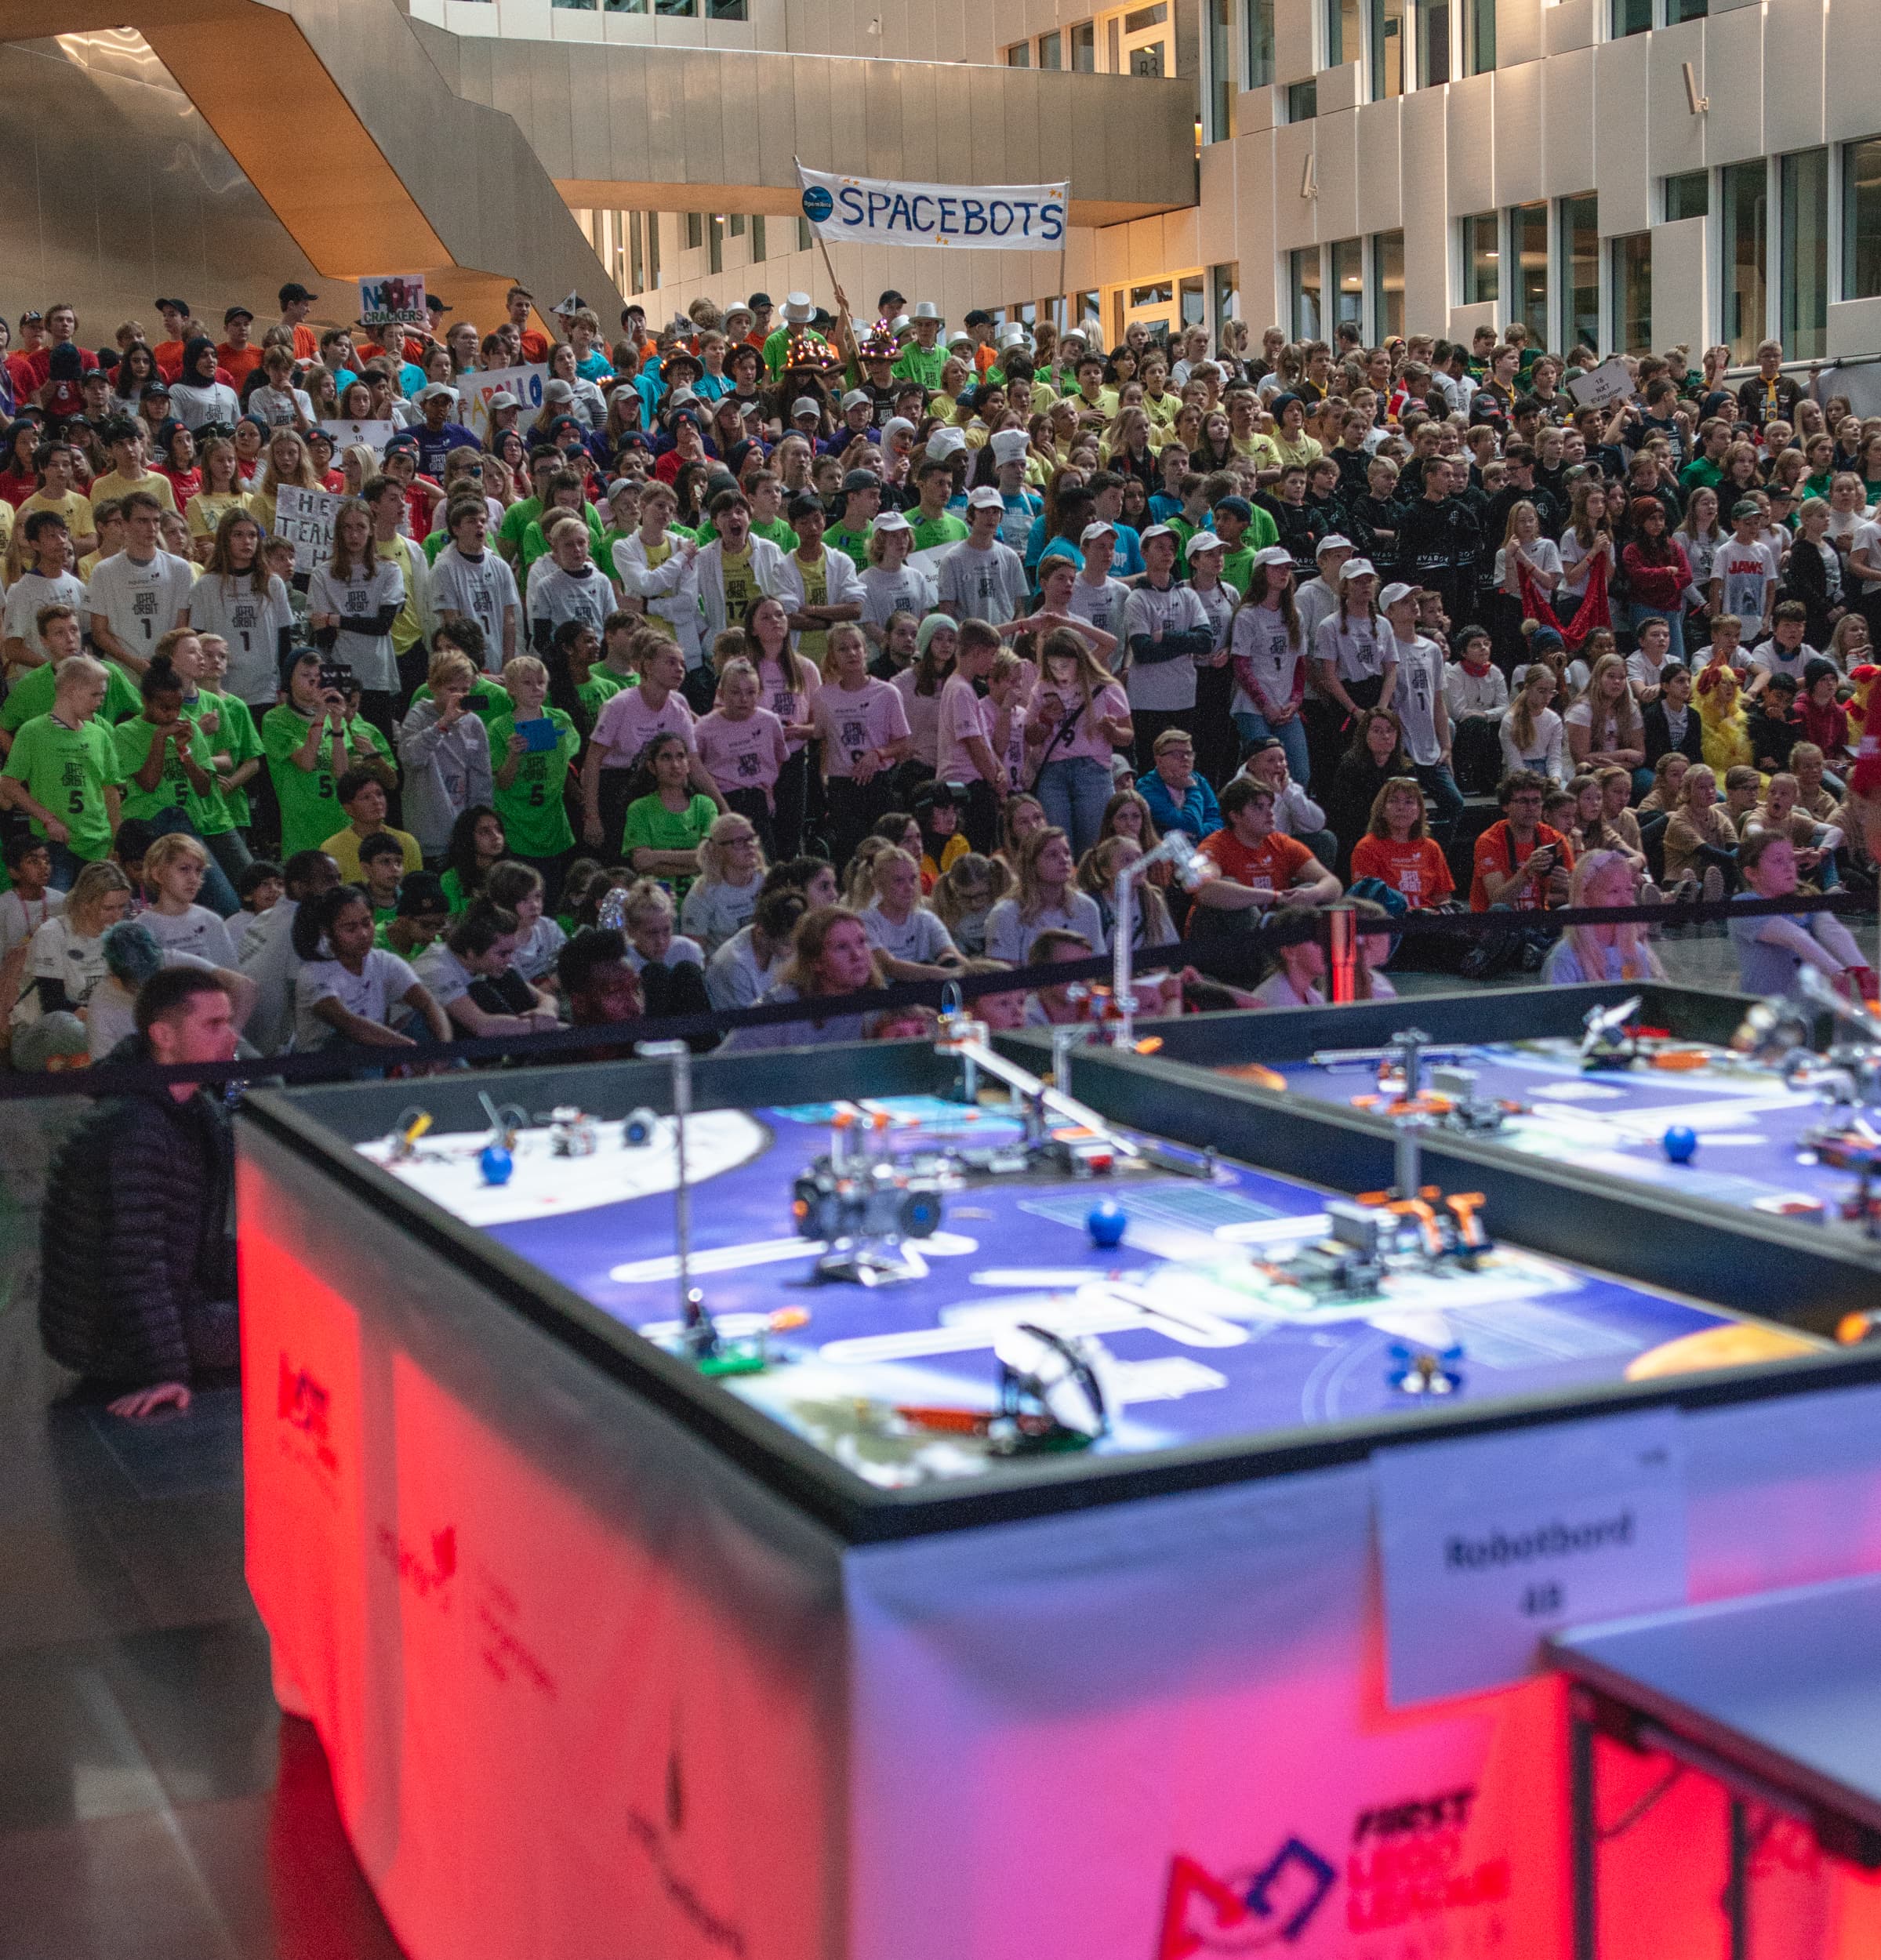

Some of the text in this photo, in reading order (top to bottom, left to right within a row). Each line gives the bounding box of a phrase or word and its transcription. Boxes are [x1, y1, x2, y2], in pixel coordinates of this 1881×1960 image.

[839, 187, 1062, 241] SPACEBOTS
[363, 310, 424, 323] CRACKERS
[1595, 382, 1610, 394] NXT
[1728, 560, 1763, 575] JAWS
[136, 593, 155, 604] INTO
[347, 590, 367, 601] INTO
[133, 603, 158, 615] ORBIT
[235, 605, 253, 616] INTO
[344, 601, 369, 613] ORBIT
[726, 600, 750, 619] 17
[140, 618, 151, 640] 1
[231, 615, 258, 628] ORBIT
[481, 615, 490, 635] 1
[239, 630, 250, 652] 1
[1273, 656, 1281, 671] 1
[1417, 692, 1425, 711] 1
[175, 783, 189, 806] 5
[319, 775, 332, 798] 5
[529, 784, 544, 806] 5
[68, 790, 84, 814] 5
[1444, 1510, 1634, 1571] Robotbord
